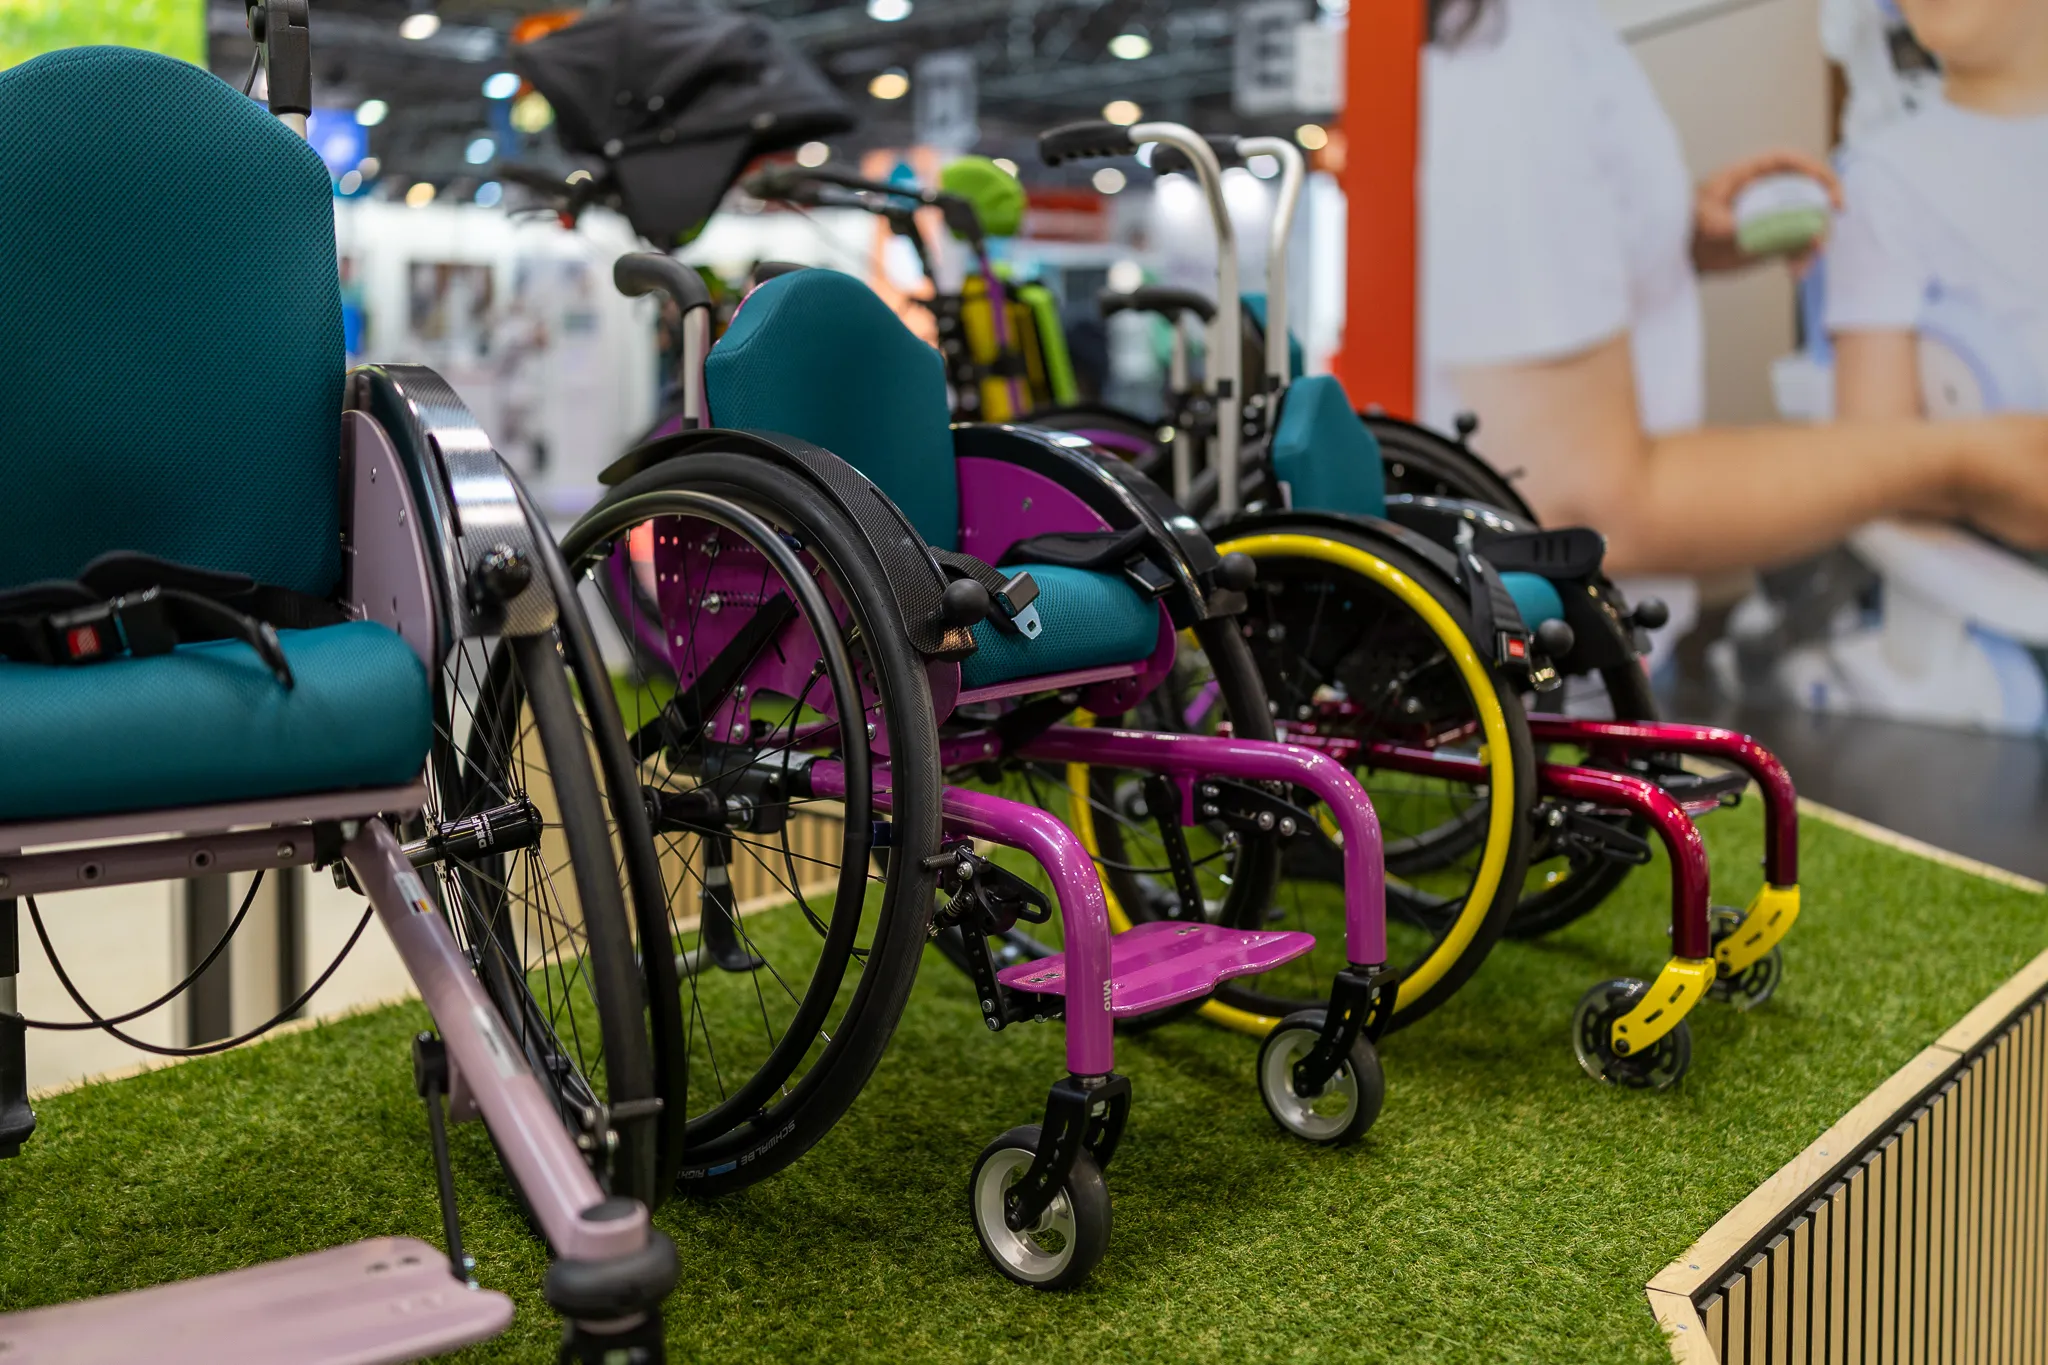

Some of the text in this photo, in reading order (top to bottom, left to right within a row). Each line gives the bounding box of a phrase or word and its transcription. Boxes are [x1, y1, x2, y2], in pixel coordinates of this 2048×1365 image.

[470, 815, 487, 848] DELFI
[1103, 979, 1112, 1011] Mio
[741, 1120, 796, 1166] SCHWALBE
